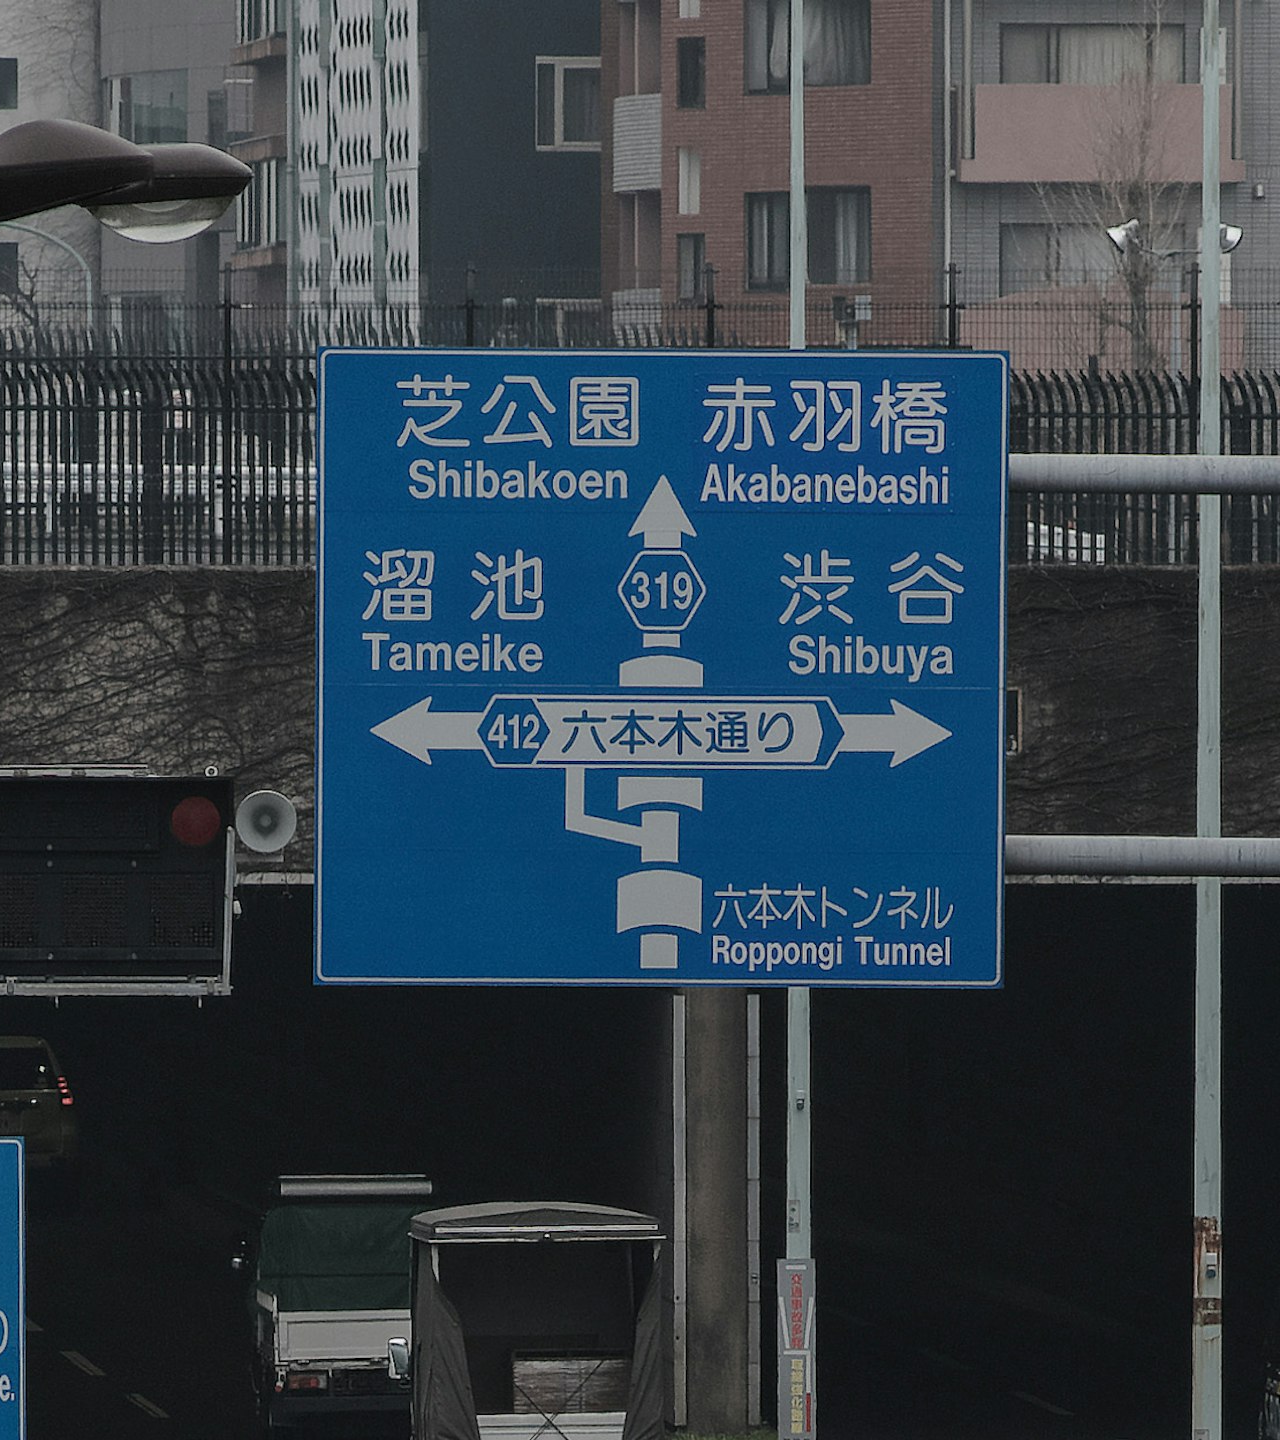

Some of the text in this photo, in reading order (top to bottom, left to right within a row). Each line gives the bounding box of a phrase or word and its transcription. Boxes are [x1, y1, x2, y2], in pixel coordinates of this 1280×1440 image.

[395, 373, 950, 456] 芝公園 赤羽橋
[407, 459, 951, 506] Shibakoen Akabanebashi
[629, 570, 695, 611] 319
[777, 549, 966, 628] 渋谷
[361, 632, 545, 675] Tameike
[787, 634, 954, 684] Shibuya
[486, 715, 541, 752] 412
[561, 709, 796, 756] 六本木通り
[711, 883, 955, 932] 六本木トンネル
[711, 935, 952, 973] Roppongi Tunnel
